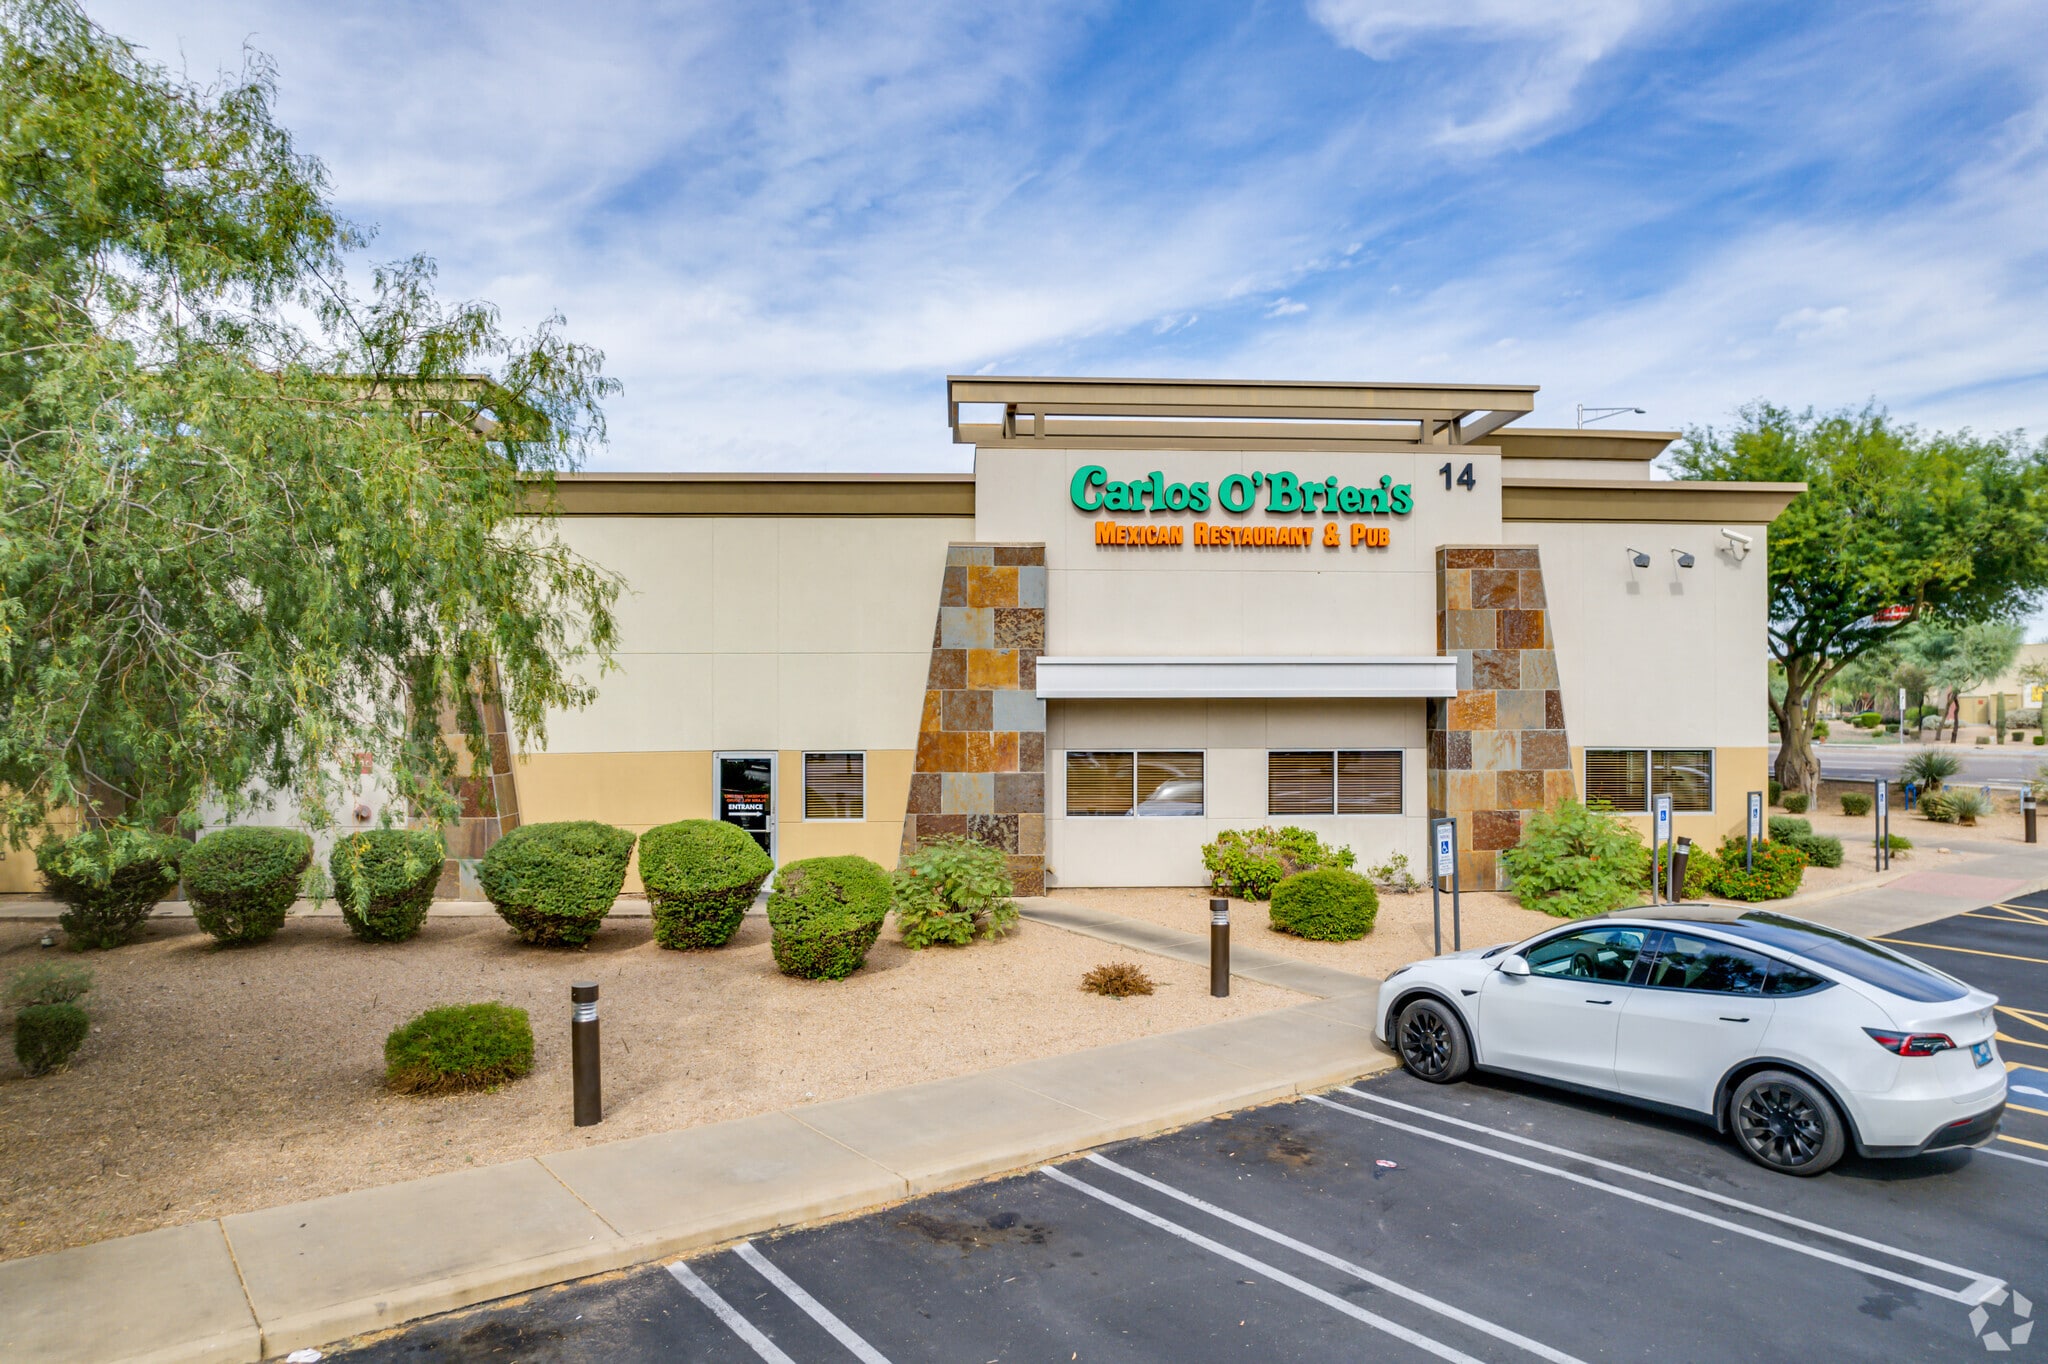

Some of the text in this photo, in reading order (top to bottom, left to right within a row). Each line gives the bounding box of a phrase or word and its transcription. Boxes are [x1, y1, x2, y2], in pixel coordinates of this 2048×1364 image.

[1070, 465, 1414, 515] Carlos O'Brien's
[1439, 462, 1476, 491] 14
[1095, 521, 1390, 547] MEXICAN RESTAURANT & PUB
